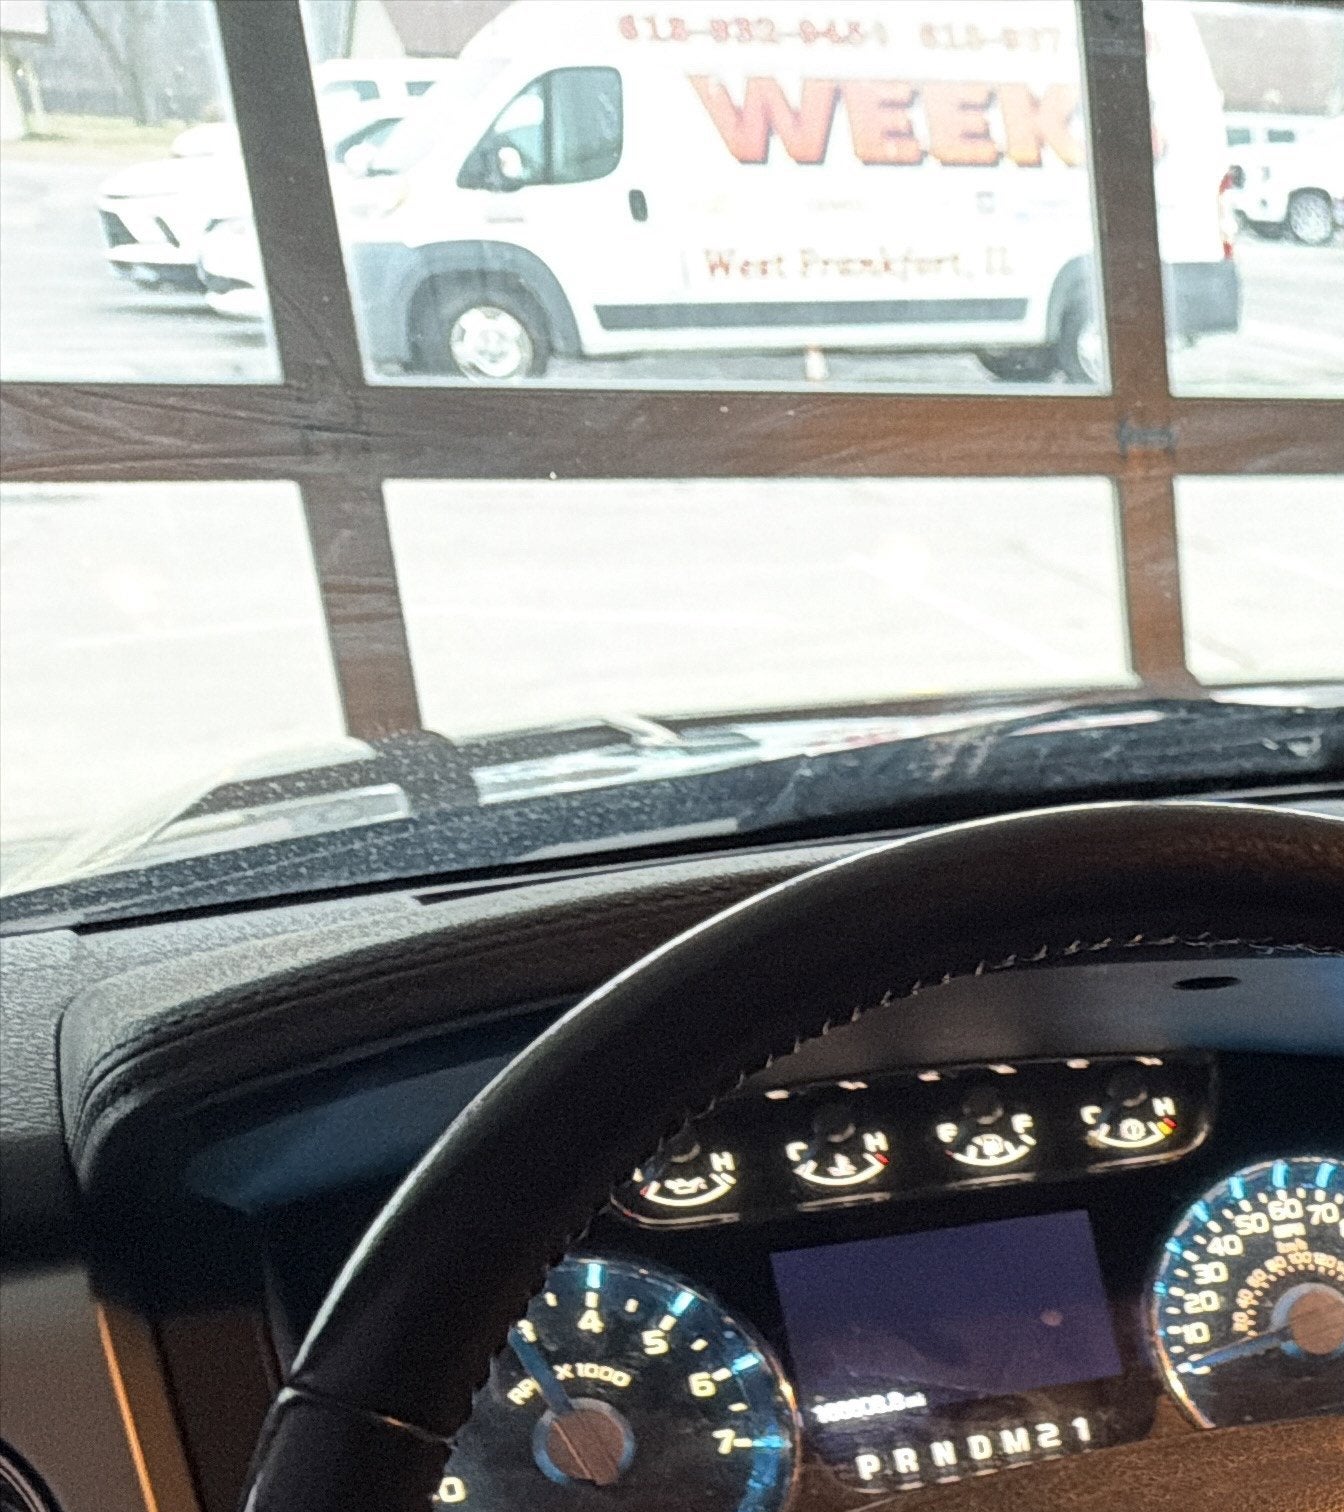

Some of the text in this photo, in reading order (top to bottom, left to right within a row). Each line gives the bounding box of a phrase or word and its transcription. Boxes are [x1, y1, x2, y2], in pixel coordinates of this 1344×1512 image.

[688, 74, 1090, 168] WEEK
[1152, 1097, 1176, 1117] H
[863, 1131, 889, 1152] H
[710, 1151, 735, 1172] H
[1268, 1198, 1303, 1221] 60
[1306, 1202, 1340, 1225] 70
[1234, 1212, 1269, 1236] 50
[1207, 1234, 1243, 1256] 40
[1194, 1261, 1228, 1284] 30
[1184, 1290, 1220, 1314] 20
[577, 1309, 604, 1334] 4
[1182, 1321, 1210, 1344] 10
[641, 1329, 669, 1356] 5
[689, 1371, 717, 1398] 6
[712, 1428, 738, 1455] 7
[855, 1416, 1091, 1480] P R N D M 2 1
[439, 1476, 467, 1503] 0
